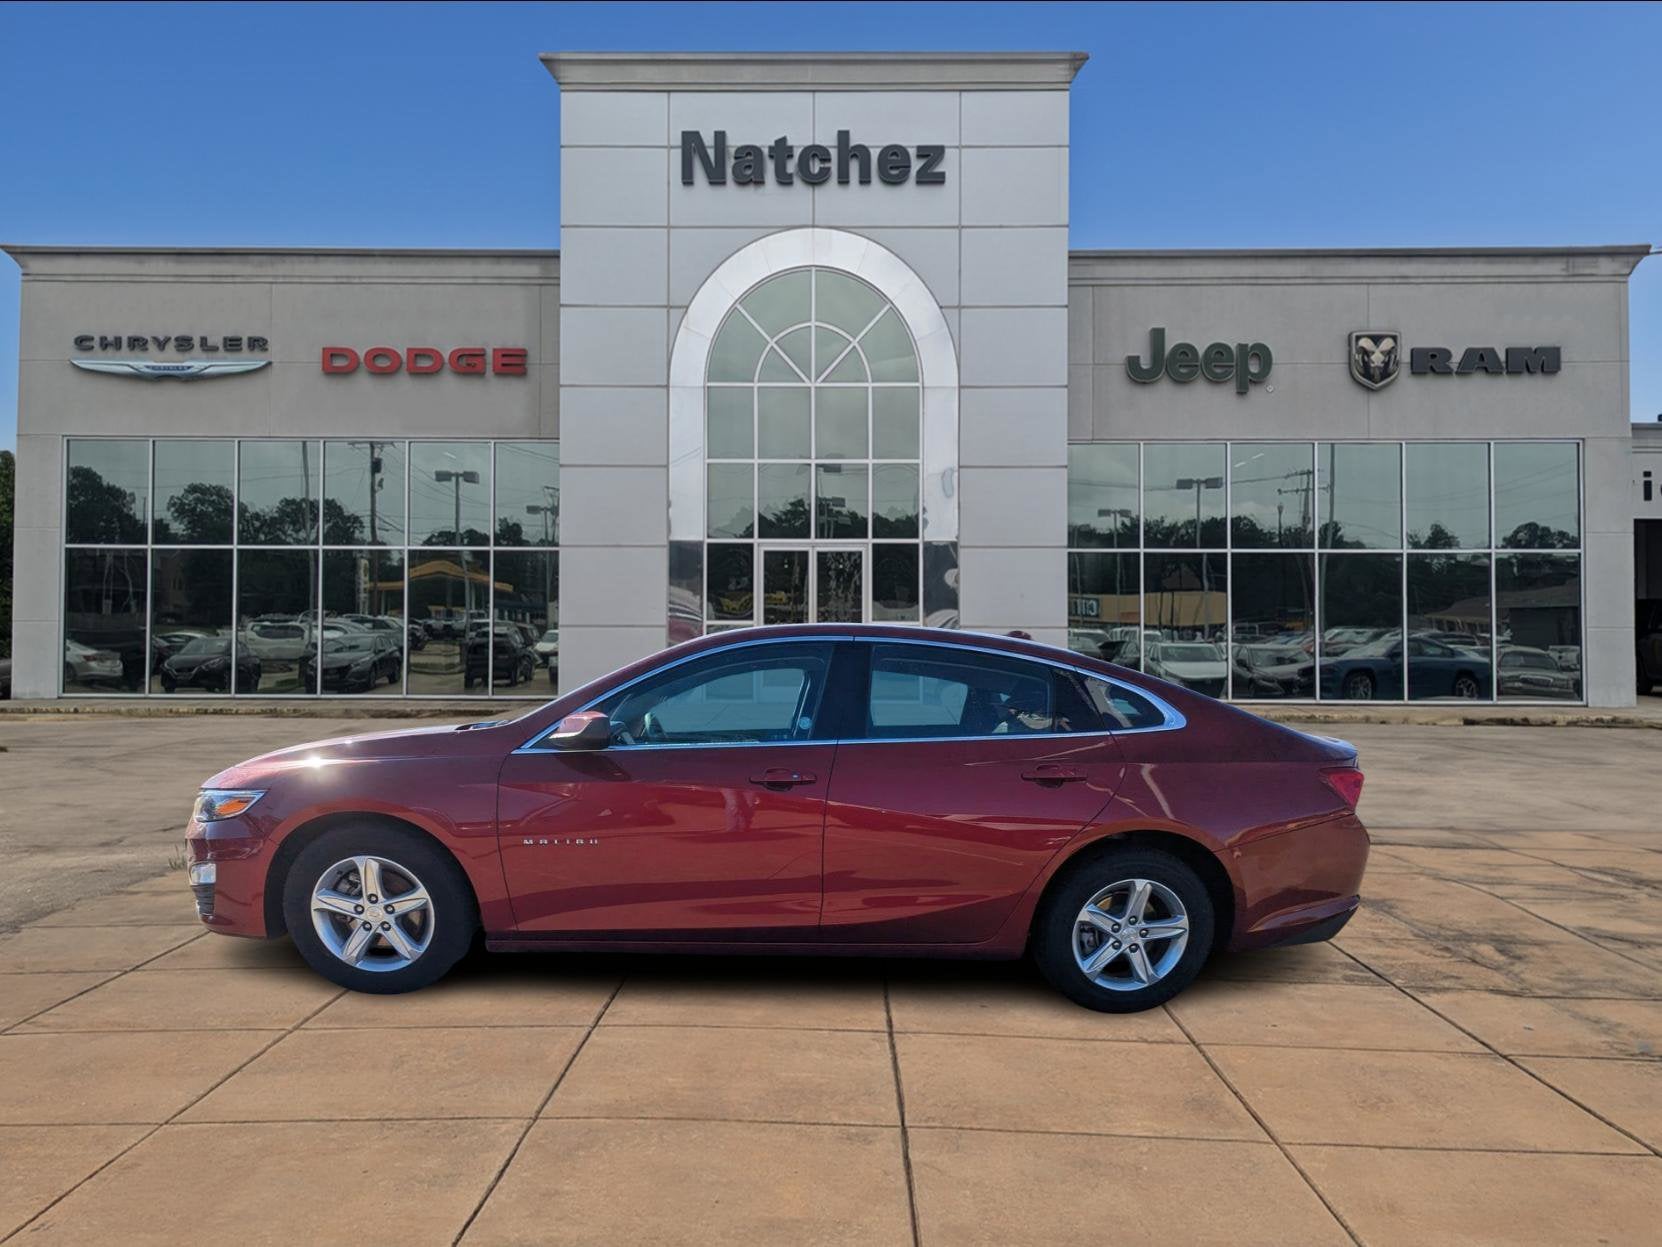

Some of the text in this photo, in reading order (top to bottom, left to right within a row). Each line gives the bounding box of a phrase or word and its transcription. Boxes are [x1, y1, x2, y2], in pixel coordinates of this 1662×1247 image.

[681, 130, 946, 186] Natchez
[74, 335, 269, 352] CHRYSLER
[322, 347, 528, 375] DODGE
[1126, 327, 1273, 394] Jeep
[1410, 347, 1562, 374] RAM
